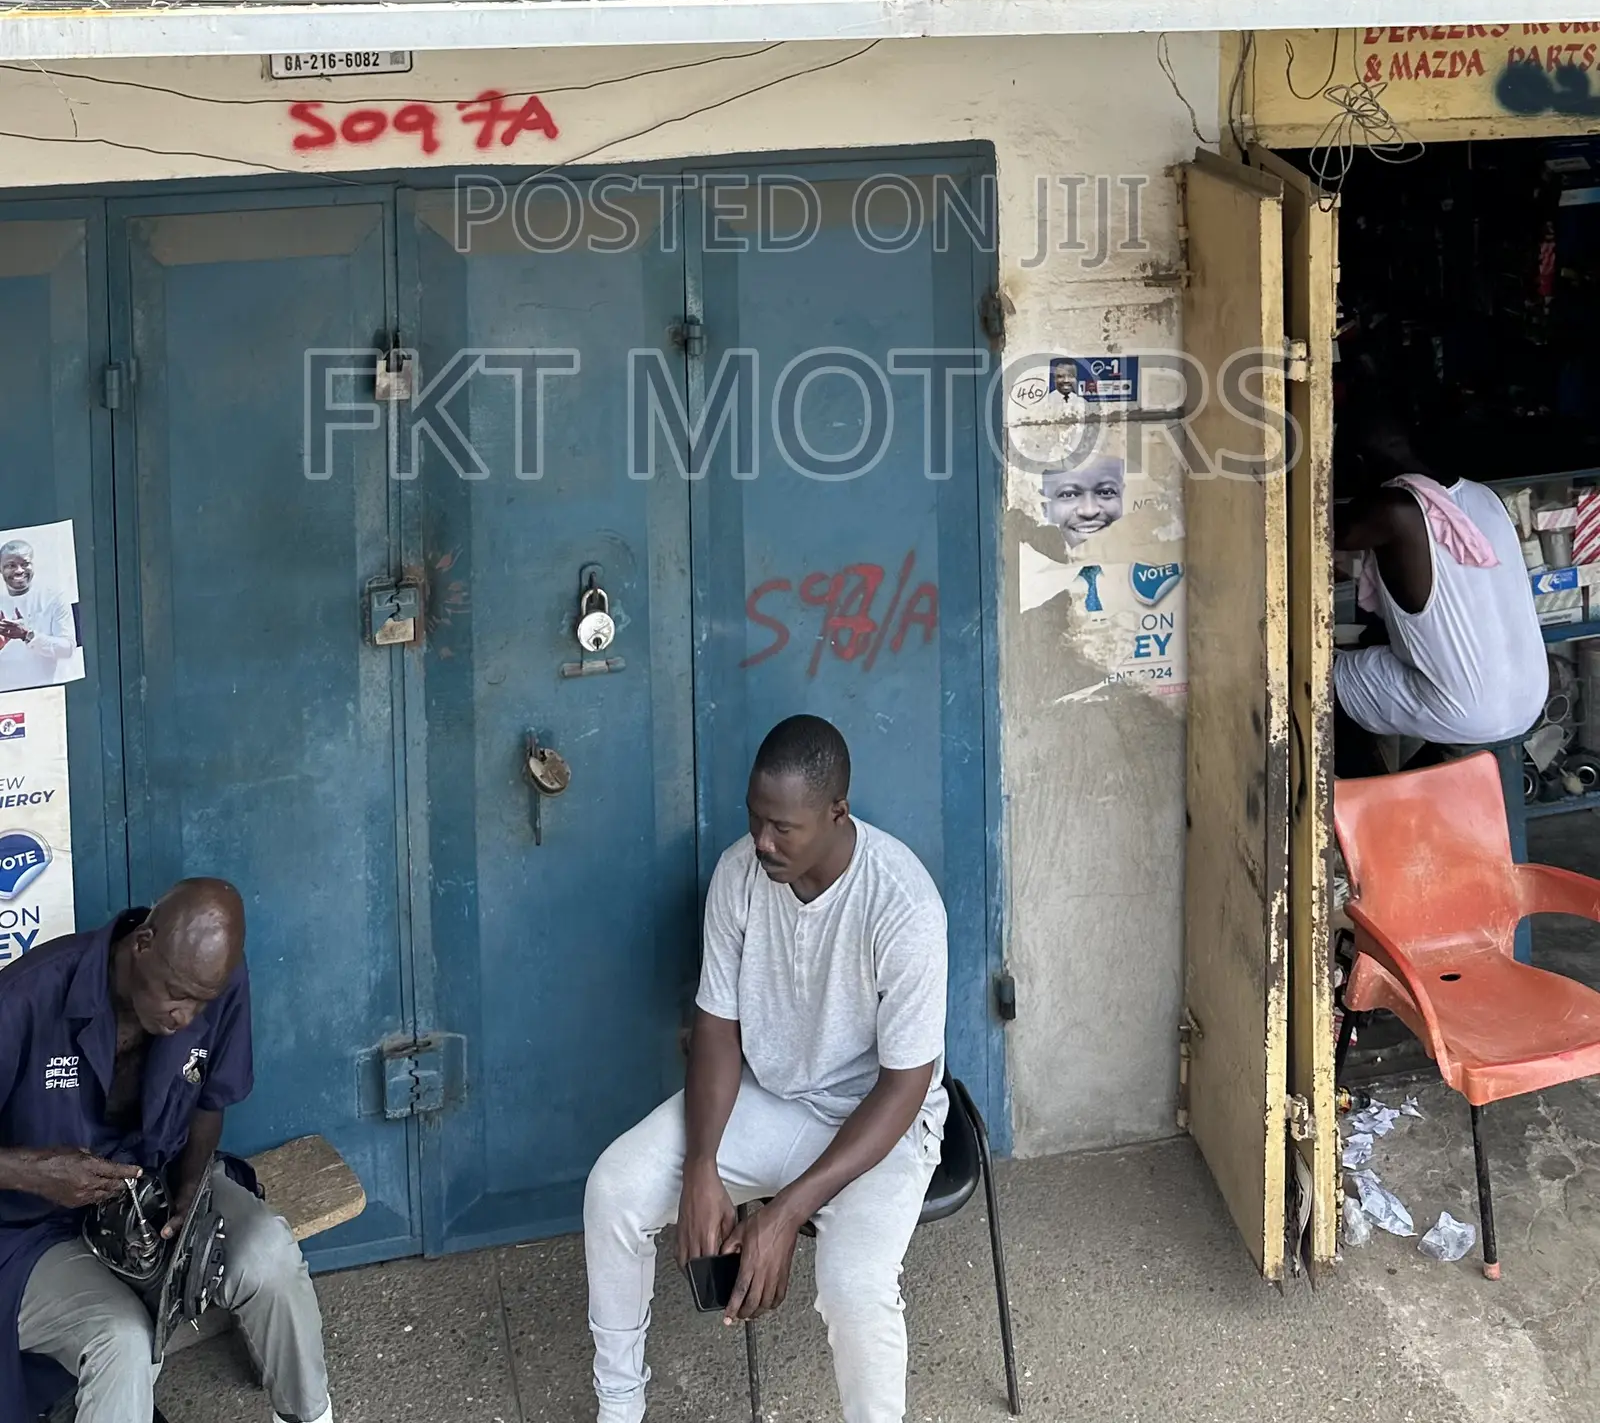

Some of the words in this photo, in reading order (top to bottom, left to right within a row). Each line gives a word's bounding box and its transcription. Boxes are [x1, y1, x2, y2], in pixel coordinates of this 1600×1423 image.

[284, 51, 380, 71] GA-216-6082
[1363, 53, 1382, 83] &
[1389, 48, 1486, 81] MAZDA
[1017, 384, 1044, 401] 460
[1138, 564, 1173, 582] VOTE
